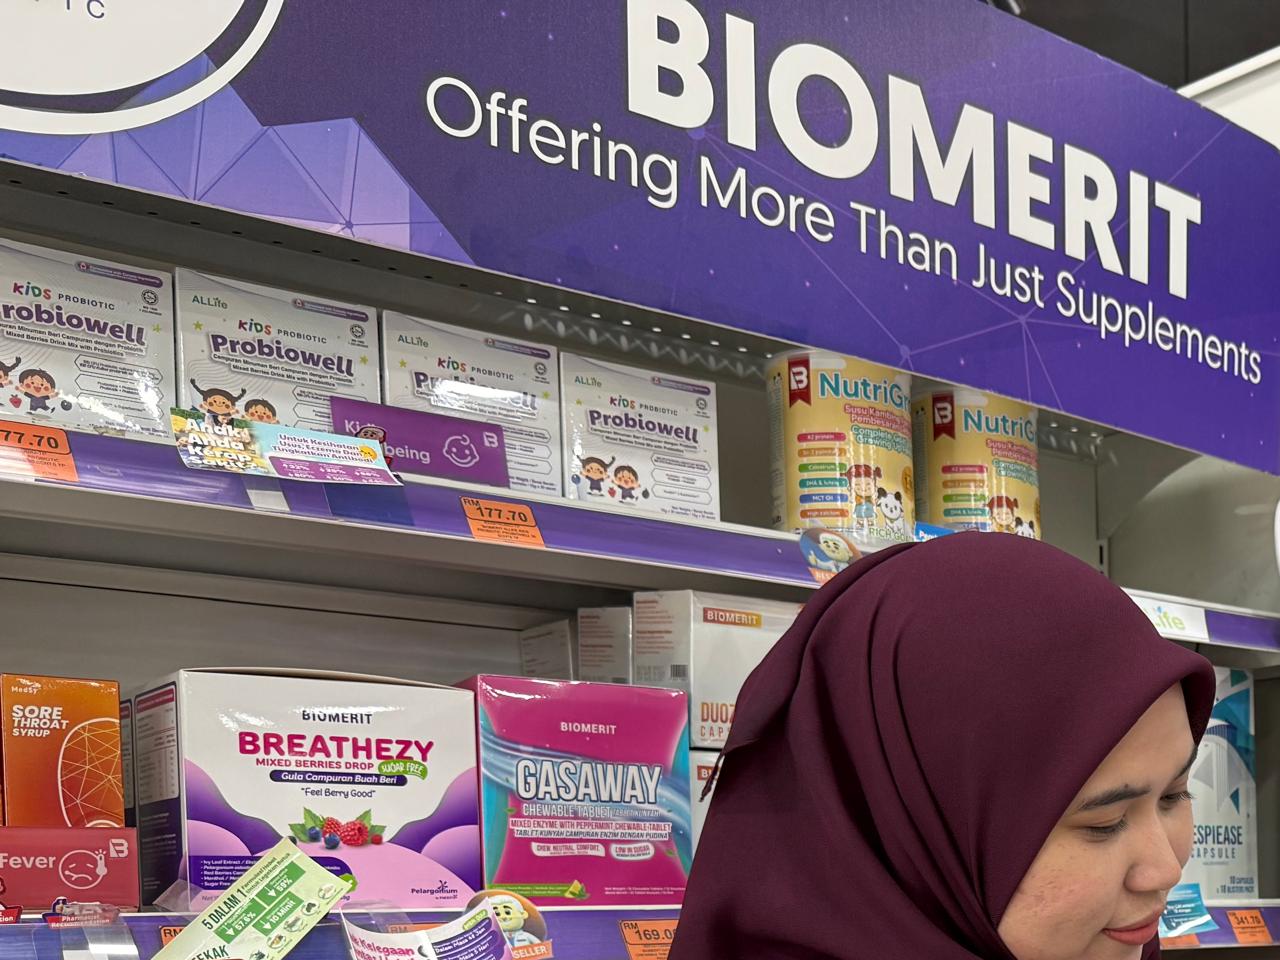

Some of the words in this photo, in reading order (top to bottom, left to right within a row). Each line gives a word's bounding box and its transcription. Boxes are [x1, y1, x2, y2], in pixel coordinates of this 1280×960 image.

[626, 0, 1202, 300] BIOMERIT
[426, 75, 679, 210] Offering
[698, 156, 836, 243] More
[851, 201, 959, 277] Than
[973, 244, 1045, 308] Just
[1056, 271, 1263, 385] Supplements
[58, 292, 116, 312] PROBIOTIC
[2, 303, 146, 346] robiowell
[277, 329, 327, 345] PROBIOTIC
[211, 334, 354, 377] Probiowell
[471, 366, 514, 380] PROBIOTIC
[639, 403, 678, 416] PROBIOTIC
[589, 409, 699, 444] Probiowell
[852, 425, 892, 440] Complete
[463, 498, 480, 507] RM
[476, 506, 528, 522] 177.70
[707, 610, 758, 625] BIOMERIT
[12, 705, 63, 720] SORE
[302, 710, 372, 725] BIOMERIT
[12, 717, 69, 729] THROAT
[560, 722, 616, 735] BIOMERIT
[12, 728, 50, 737] SYRUP
[238, 731, 434, 762] BREATHEZY
[256, 758, 291, 768] MIXED
[294, 759, 342, 770] BERRIES
[345, 760, 374, 771] DROP
[381, 761, 404, 774] SUGAR
[405, 762, 425, 775] FREE
[281, 772, 303, 781] Gula
[305, 772, 352, 785] Campuran
[353, 774, 378, 783] Buah
[379, 775, 397, 784] Beri
[516, 759, 662, 804] GASAWAY
[325, 788, 349, 799] Berry
[523, 803, 574, 817] CHEWABLE
[577, 805, 612, 818] TABLET
[511, 820, 531, 829] MIXED
[533, 820, 559, 829] ENZYME
[560, 821, 575, 829] WITH
[576, 821, 613, 831] PEPPERMINT
[615, 823, 646, 831] CHEWABLE
[516, 829, 538, 837] TABLET
[540, 829, 564, 838] KUNYAH
[566, 830, 598, 838] CAMPURAN
[620, 831, 643, 839] DENGAN
[0, 852, 56, 869] Fever
[202, 919, 213, 930] 5
[208, 894, 241, 925] DALAM
[277, 899, 296, 917] Minit
[623, 922, 638, 931] RM
[635, 929, 676, 940] 169.0
[360, 937, 414, 956] Kelegaan
[514, 945, 547, 959] SELLER
